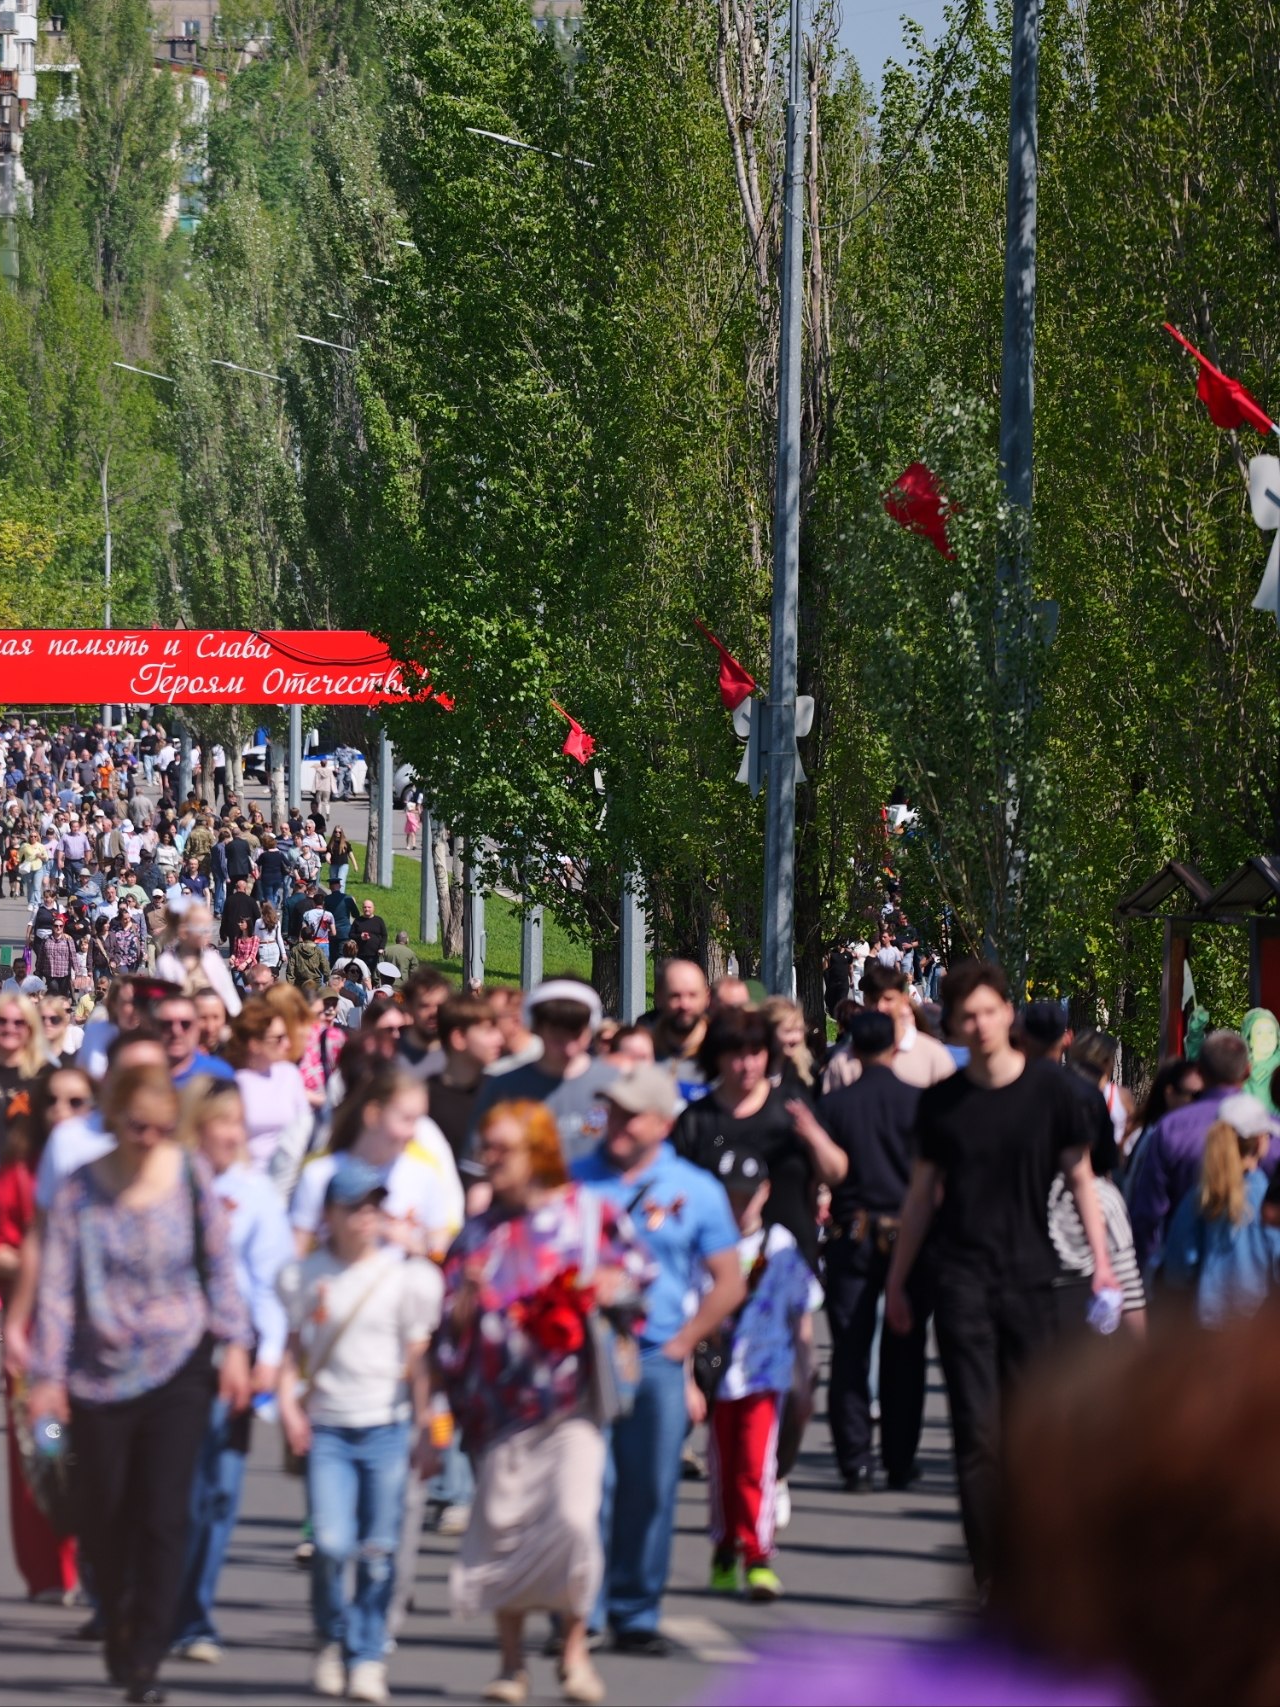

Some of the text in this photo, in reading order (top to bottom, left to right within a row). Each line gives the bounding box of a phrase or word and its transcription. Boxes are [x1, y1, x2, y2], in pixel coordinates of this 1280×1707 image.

[47, 635, 150, 657] память
[163, 639, 183, 656] и
[196, 633, 273, 659] Слава
[128, 662, 245, 705] Героям
